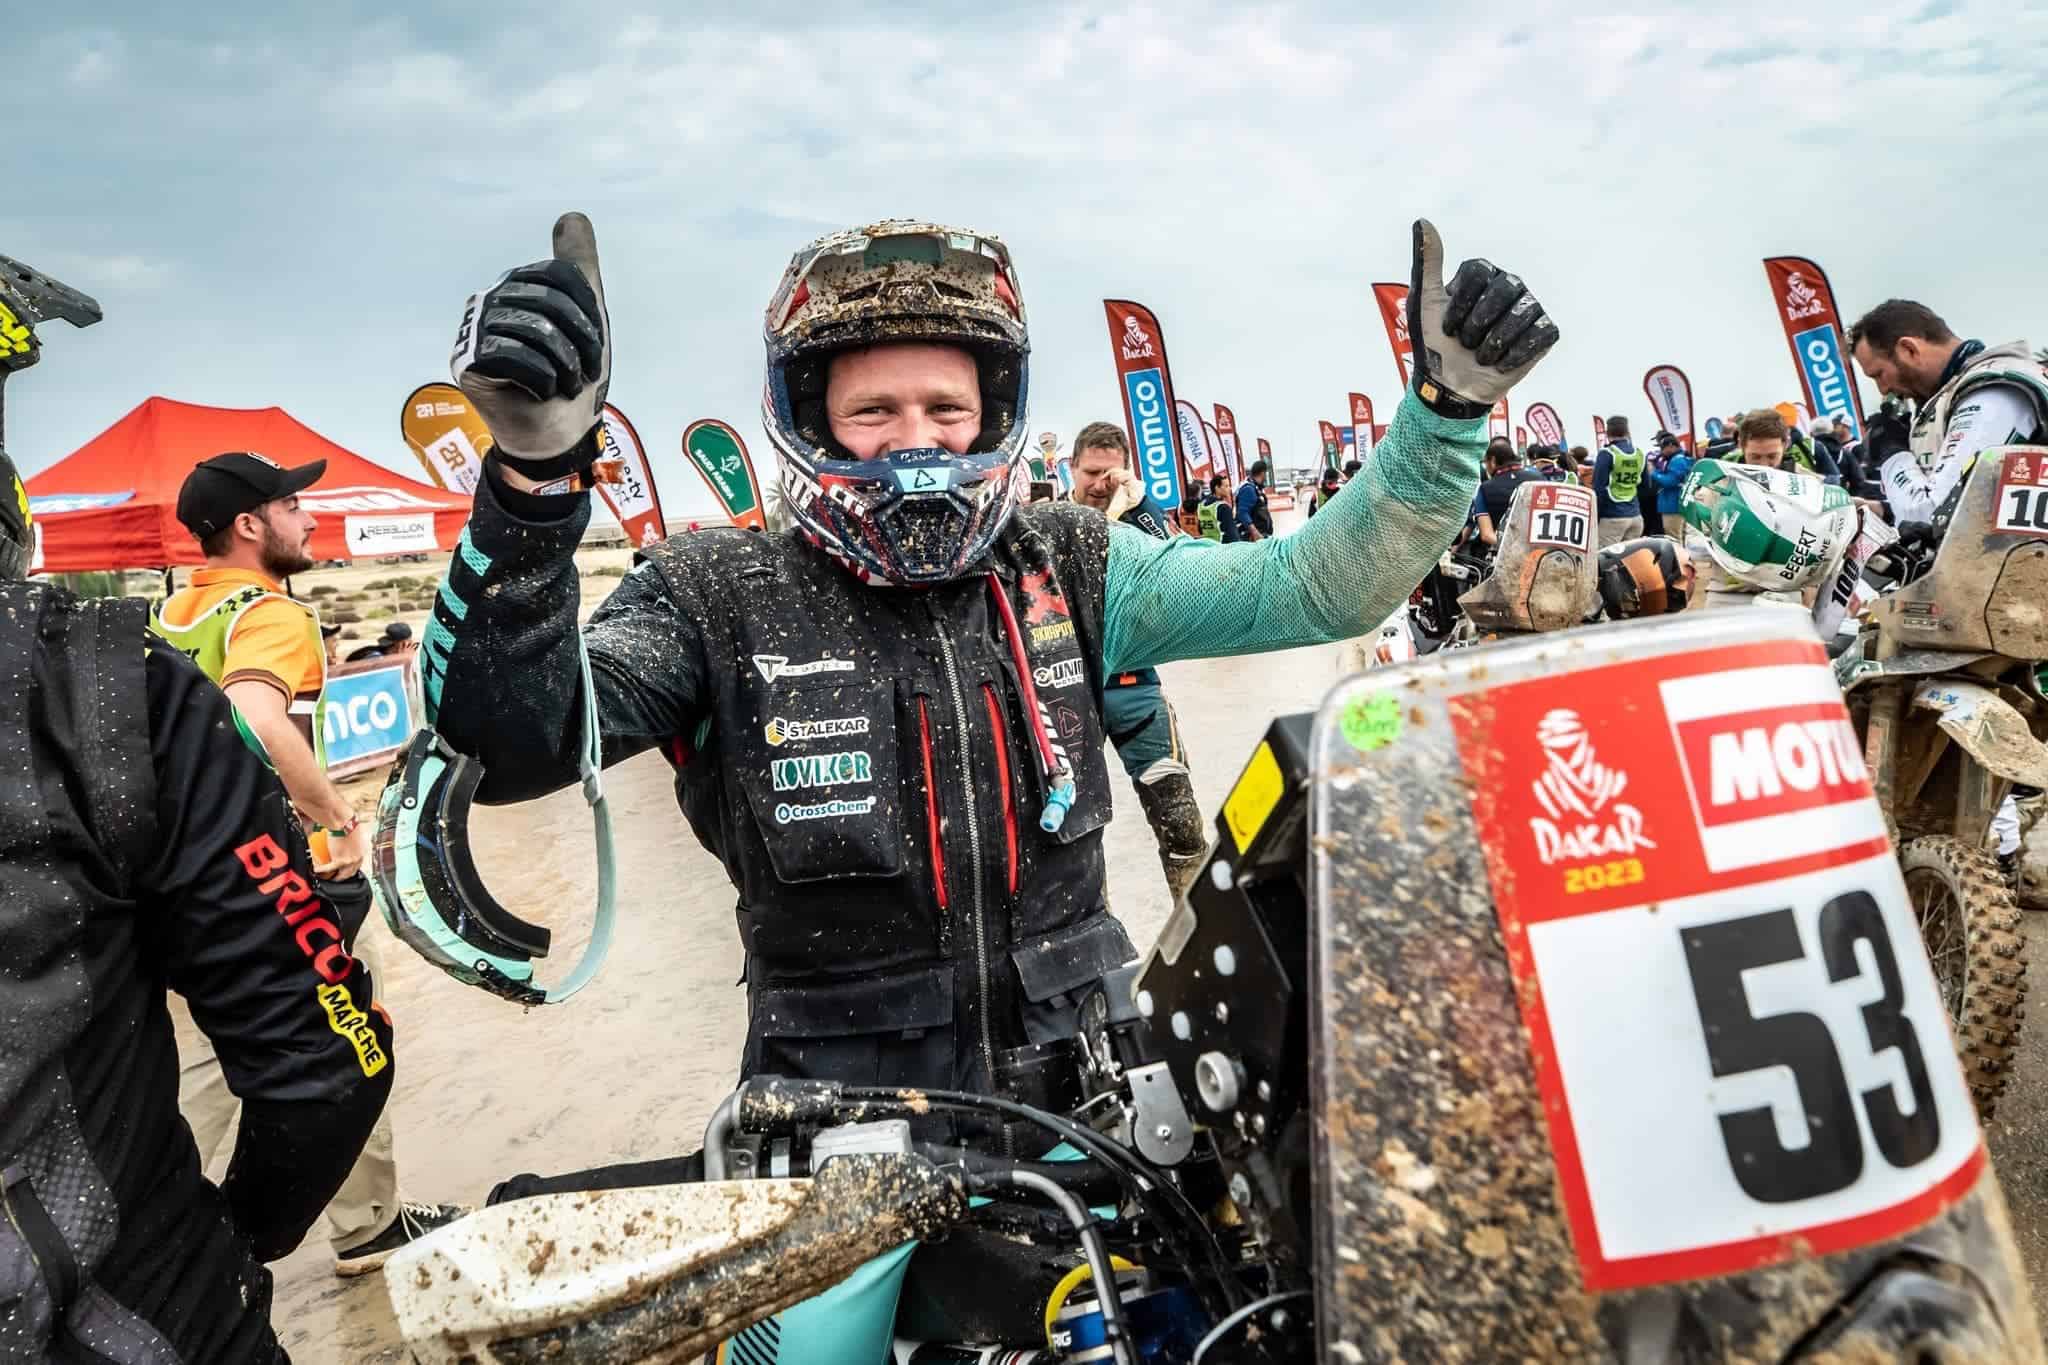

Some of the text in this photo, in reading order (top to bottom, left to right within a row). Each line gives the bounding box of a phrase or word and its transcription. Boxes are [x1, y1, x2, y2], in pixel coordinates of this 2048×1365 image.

[1787, 299, 1827, 321] DAKAR
[1123, 343, 1156, 360] DAKAR
[1135, 380, 1172, 500] aramco
[1177, 411, 1204, 461] AQUAFINA
[694, 449, 735, 500] SAUDI ARABIA
[1537, 512, 1584, 546] 110
[1778, 525, 1817, 581] BEBERT
[792, 803, 869, 818] CrossChem
[1529, 803, 1657, 865] DAKAR
[1563, 857, 1645, 894] 2023
[233, 833, 353, 985] BRICO
[1680, 890, 1941, 1205] 53
